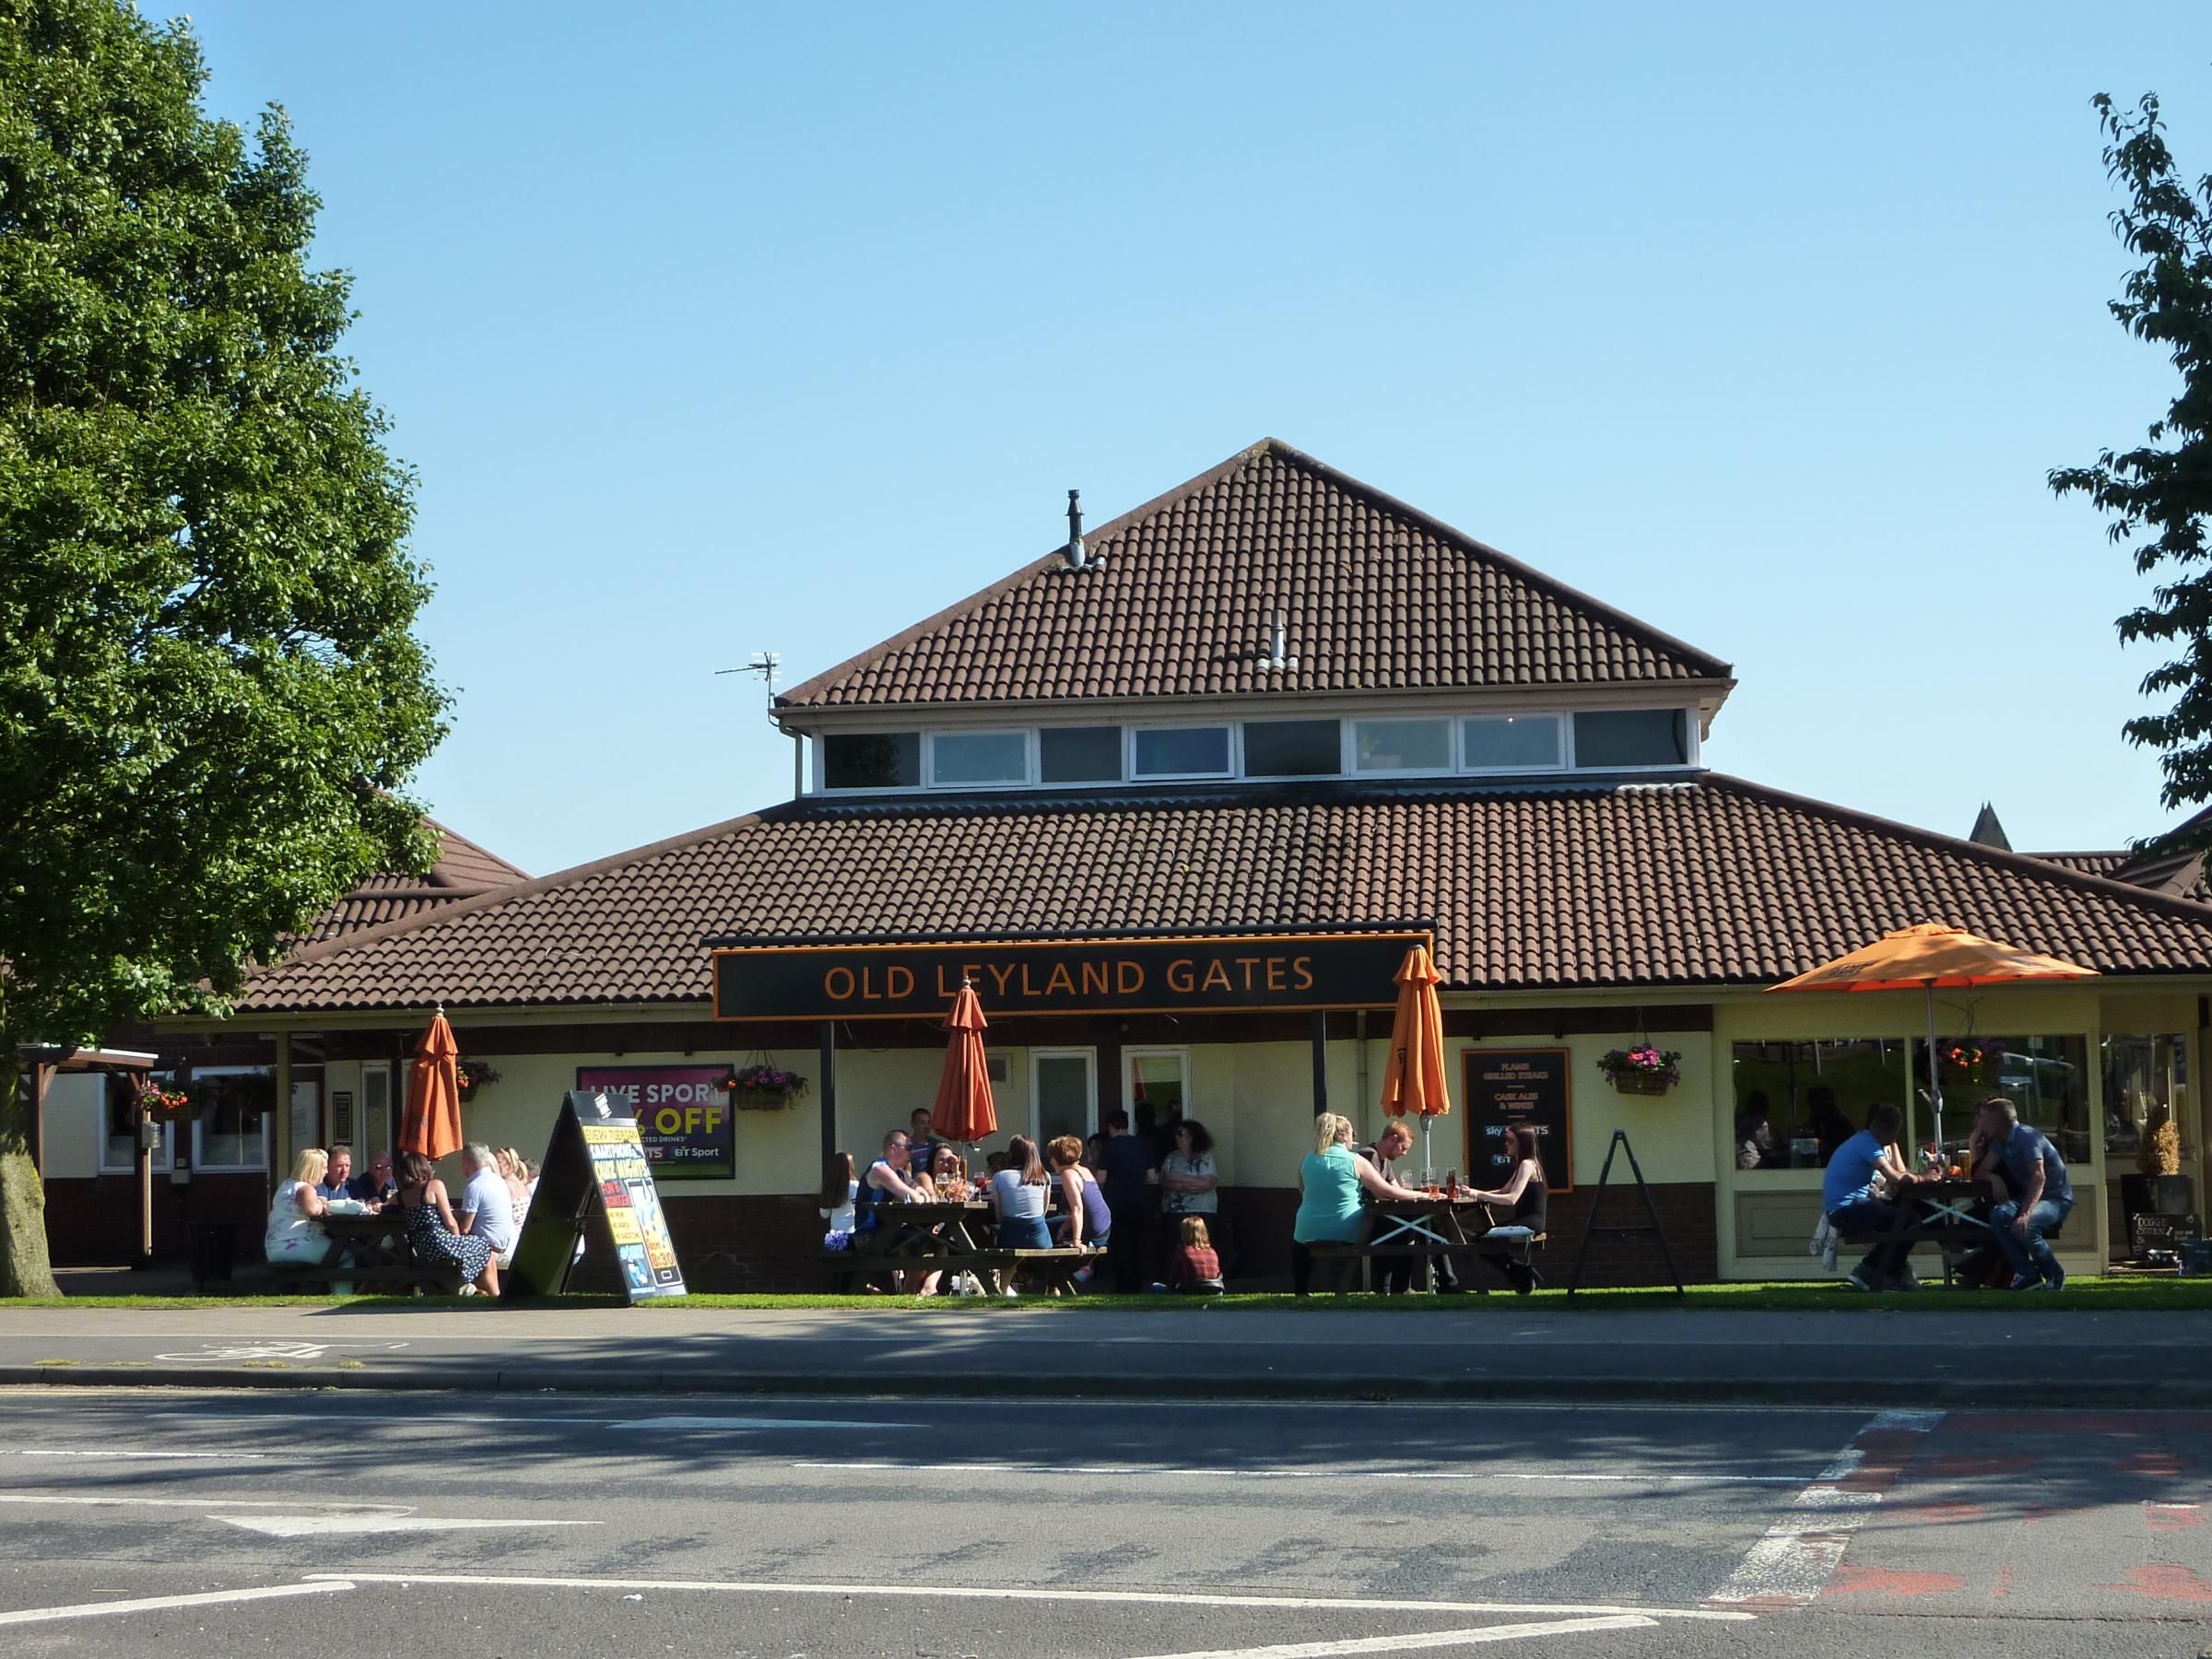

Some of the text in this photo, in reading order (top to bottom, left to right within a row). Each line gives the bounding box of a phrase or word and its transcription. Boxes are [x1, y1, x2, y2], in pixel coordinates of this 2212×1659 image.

[825, 956, 1313, 1000] OLD LEYLAND GATES
[646, 1083, 714, 1103] SPOR
[655, 1107, 724, 1135] OFF
[1486, 1126, 1502, 1136] sky
[675, 1147, 690, 1157] BT
[692, 1147, 719, 1159] Sport
[651, 1252, 676, 1267] 8:30
